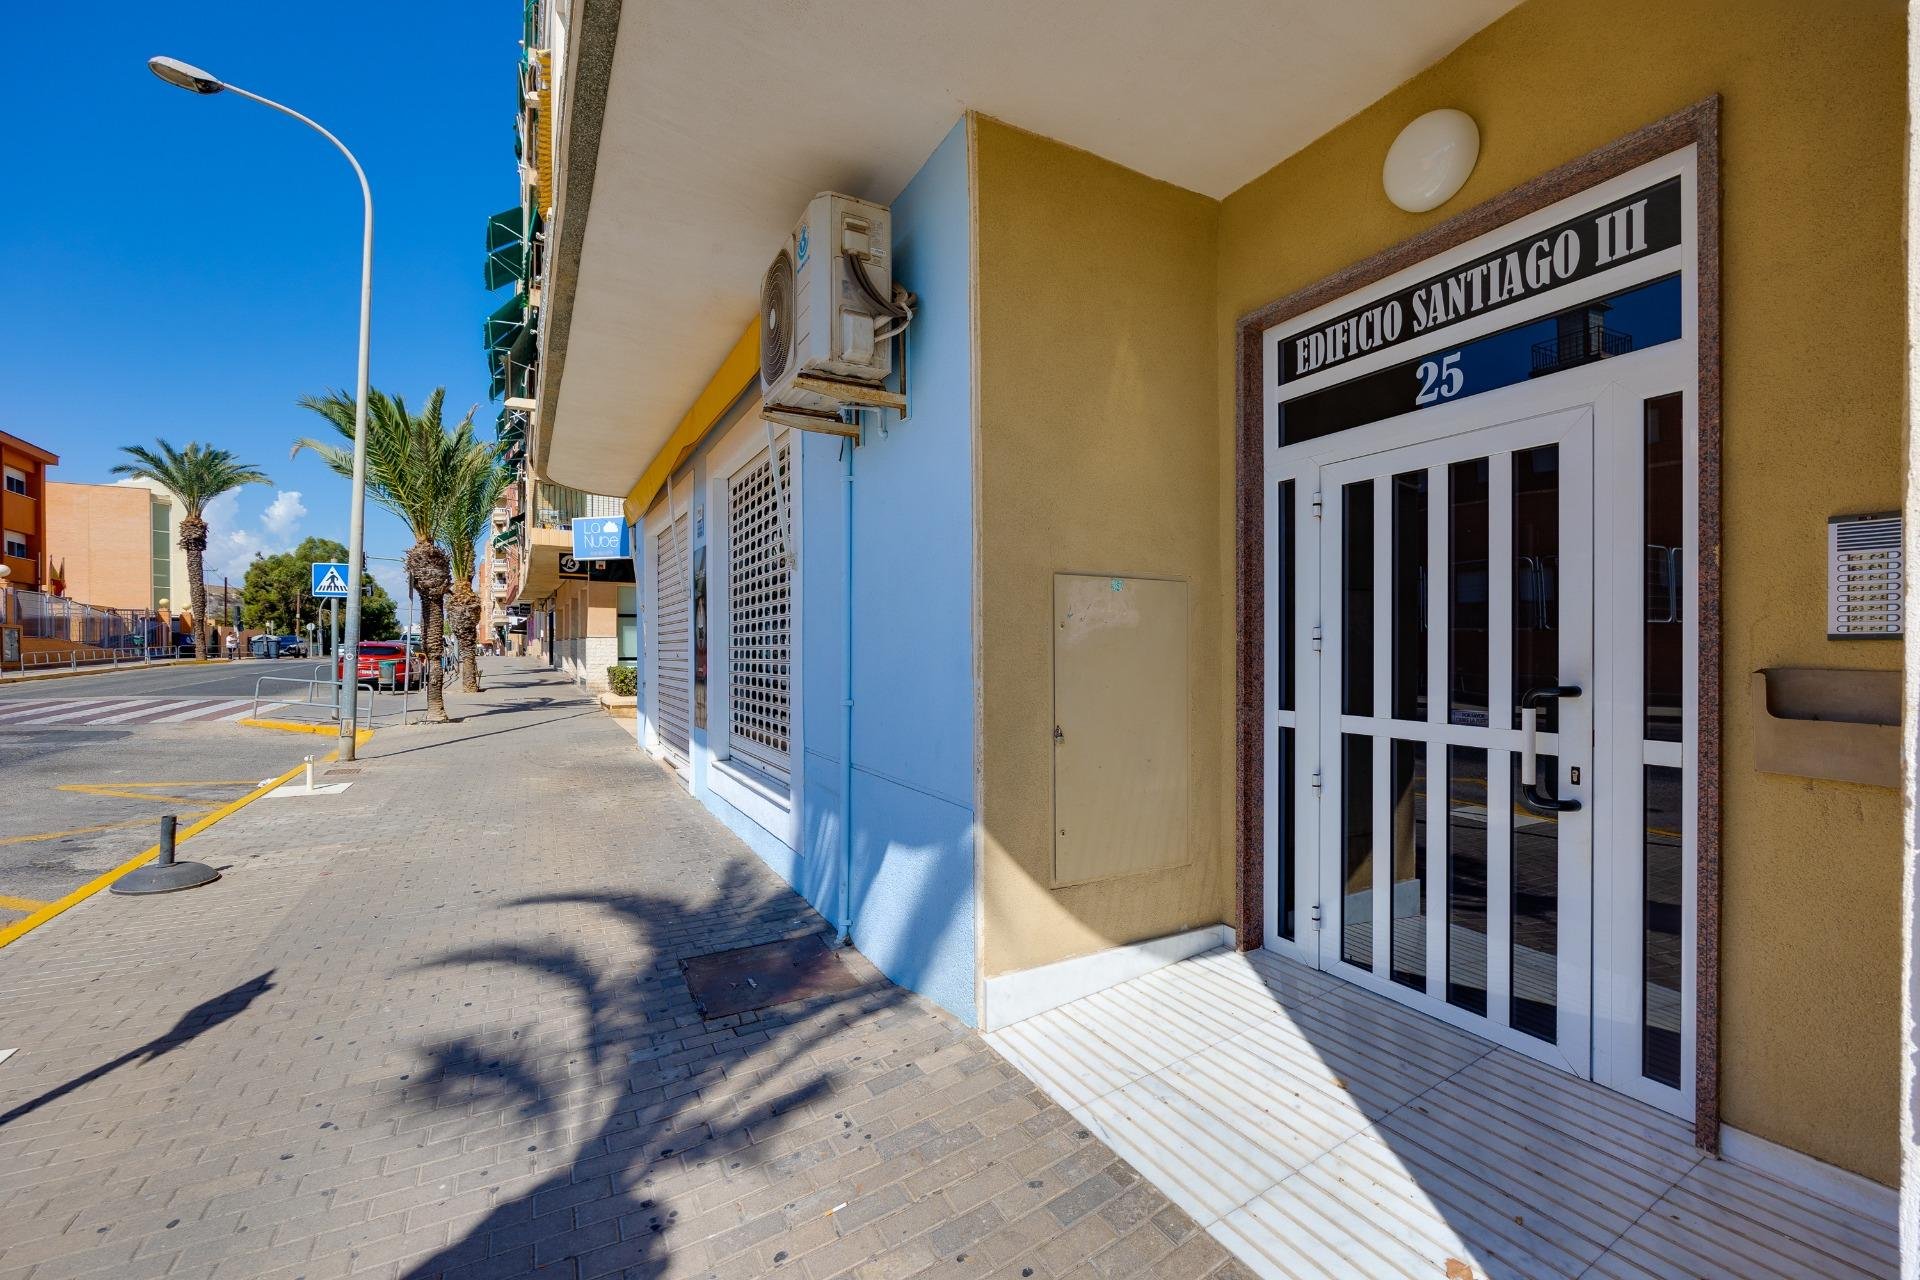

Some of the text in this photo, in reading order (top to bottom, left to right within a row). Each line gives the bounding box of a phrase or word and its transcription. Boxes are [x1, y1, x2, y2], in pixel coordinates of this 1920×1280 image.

[1295, 199, 1648, 374] EDIFICIO SANTIAGO III
[1415, 351, 1464, 405] 25
